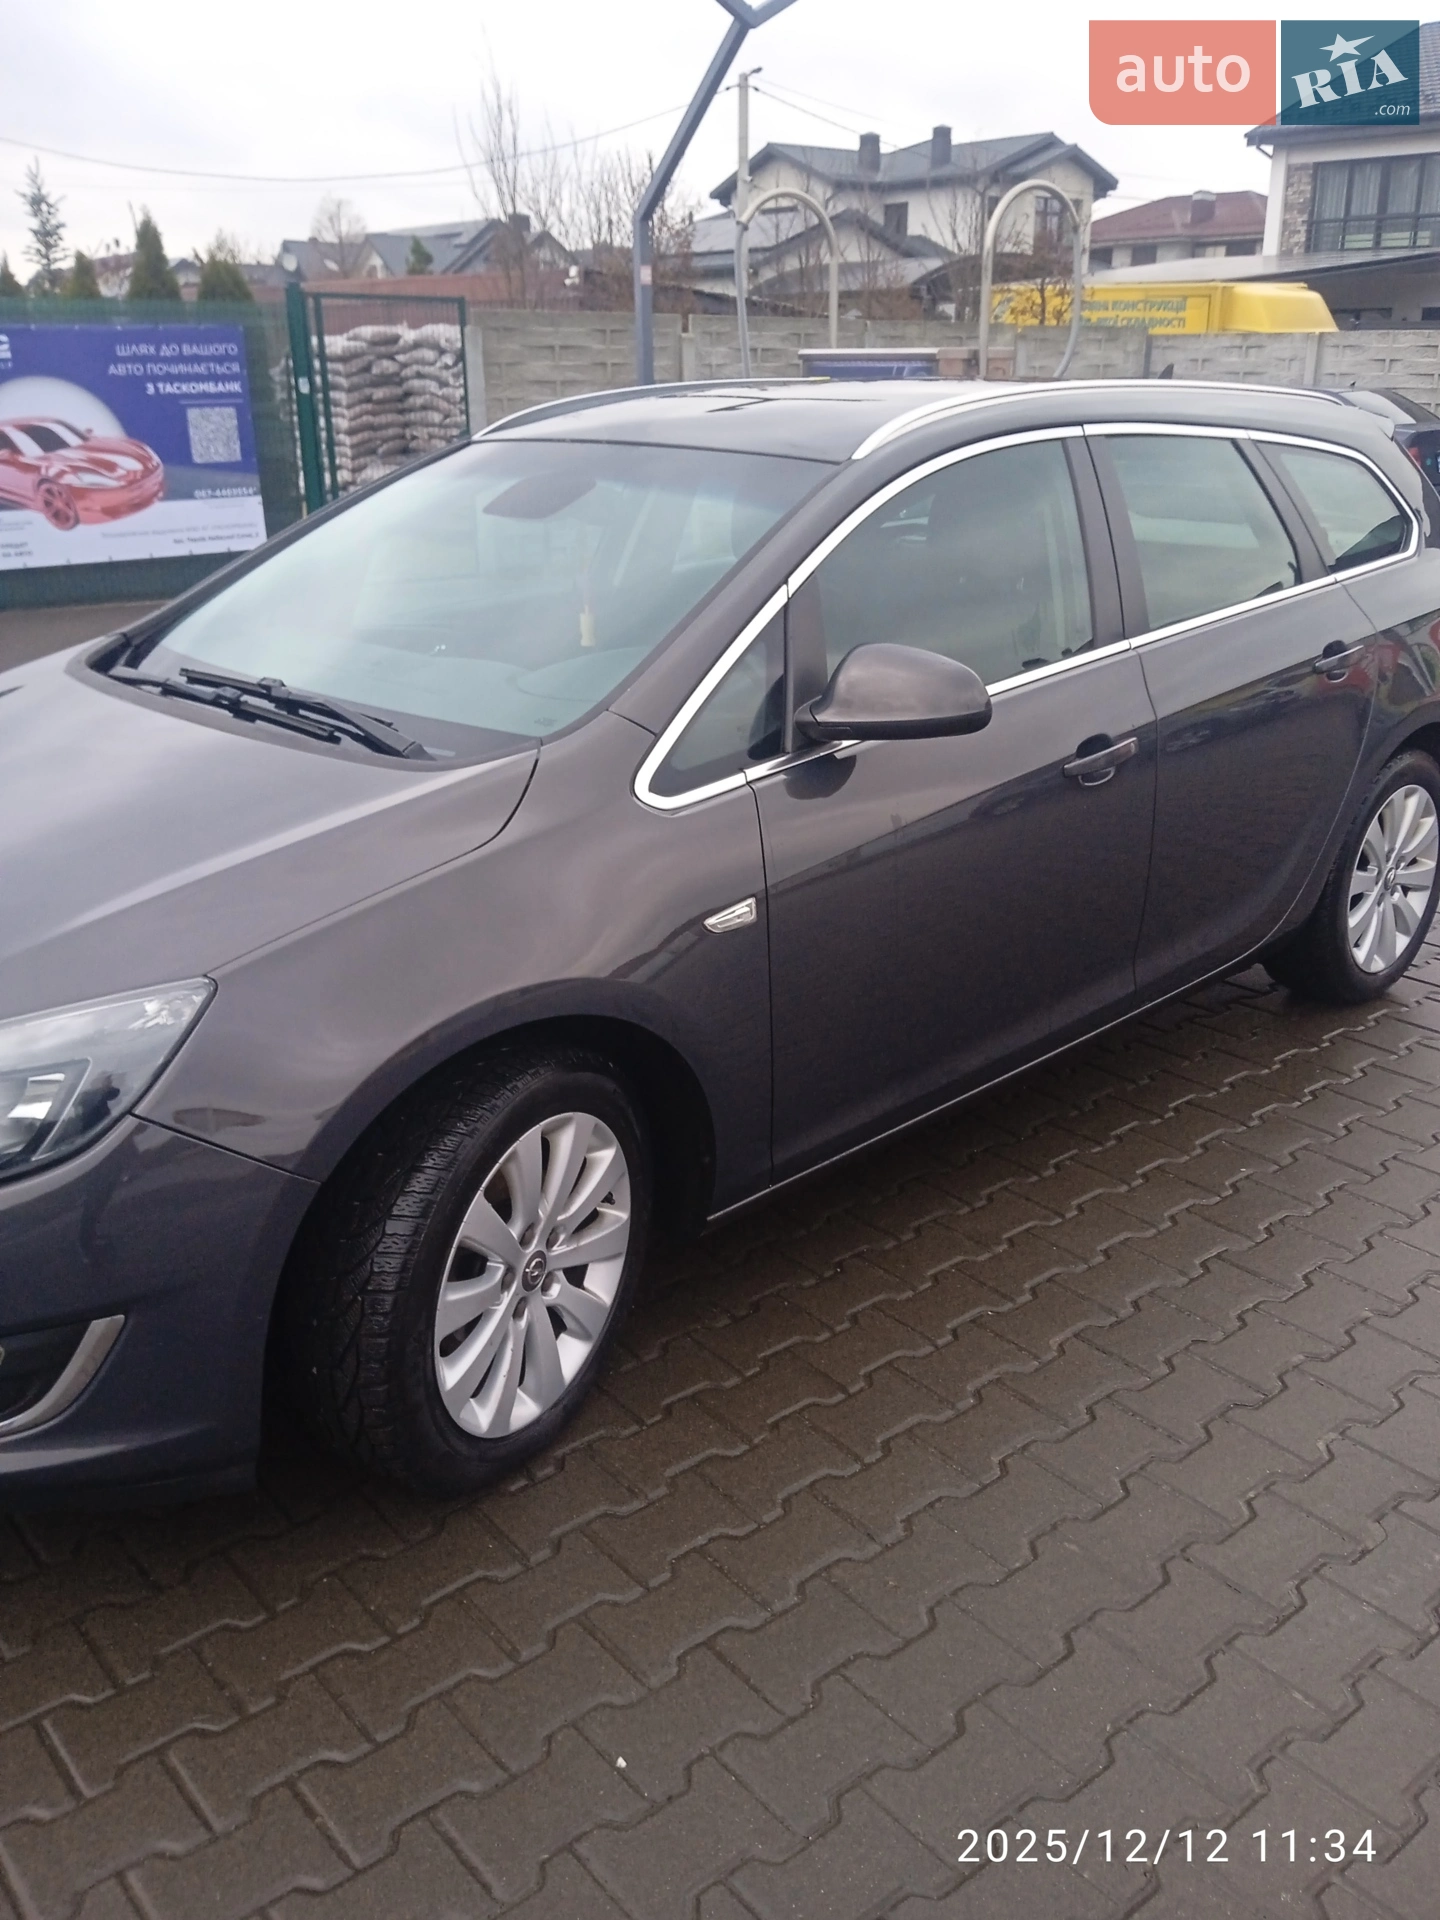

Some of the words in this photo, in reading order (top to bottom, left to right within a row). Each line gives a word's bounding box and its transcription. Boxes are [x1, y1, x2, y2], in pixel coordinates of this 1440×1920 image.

[115, 343, 156, 357] ШЛЯХ
[159, 343, 180, 357] ДО
[182, 342, 238, 356] ВАШОГО
[108, 362, 145, 376] АВТО
[146, 361, 241, 375] ПОЧИНАЄТЬСЯ
[157, 380, 242, 395] ТАСКОМБАНК
